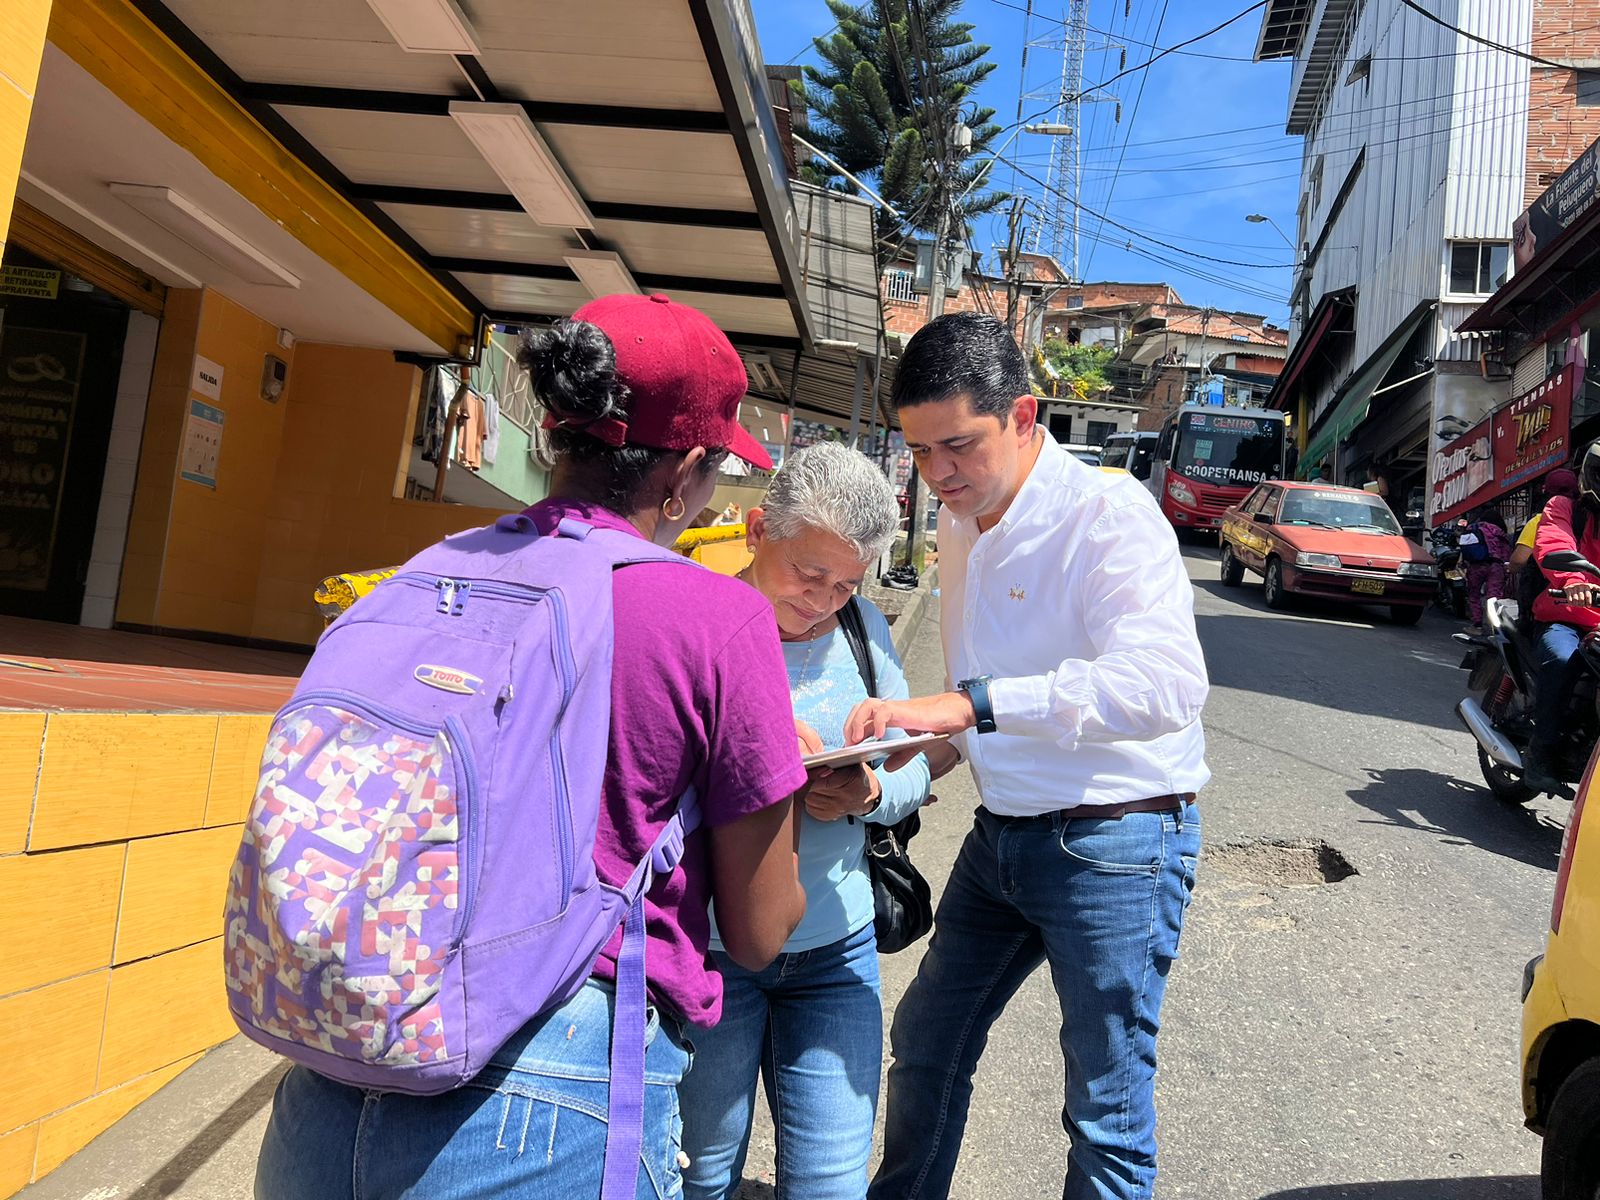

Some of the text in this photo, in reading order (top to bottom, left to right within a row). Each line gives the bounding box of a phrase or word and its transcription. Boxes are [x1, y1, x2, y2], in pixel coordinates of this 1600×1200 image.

[1546, 192, 1554, 208] La
[1555, 168, 1579, 200] Fuente
[1580, 152, 1592, 174] del
[1558, 175, 1594, 215] Peluquero
[12, 267, 56, 279] ARTICULOS
[5, 276, 48, 288] RETIRARSE
[199, 371, 218, 386] SALIDA
[1510, 374, 1563, 415] TIENDAS
[1213, 417, 1256, 430] CENTRO
[1185, 465, 1267, 483] COOPETRANSA
[1321, 491, 1352, 501] RENAULT
[433, 669, 464, 684] TOTTO
